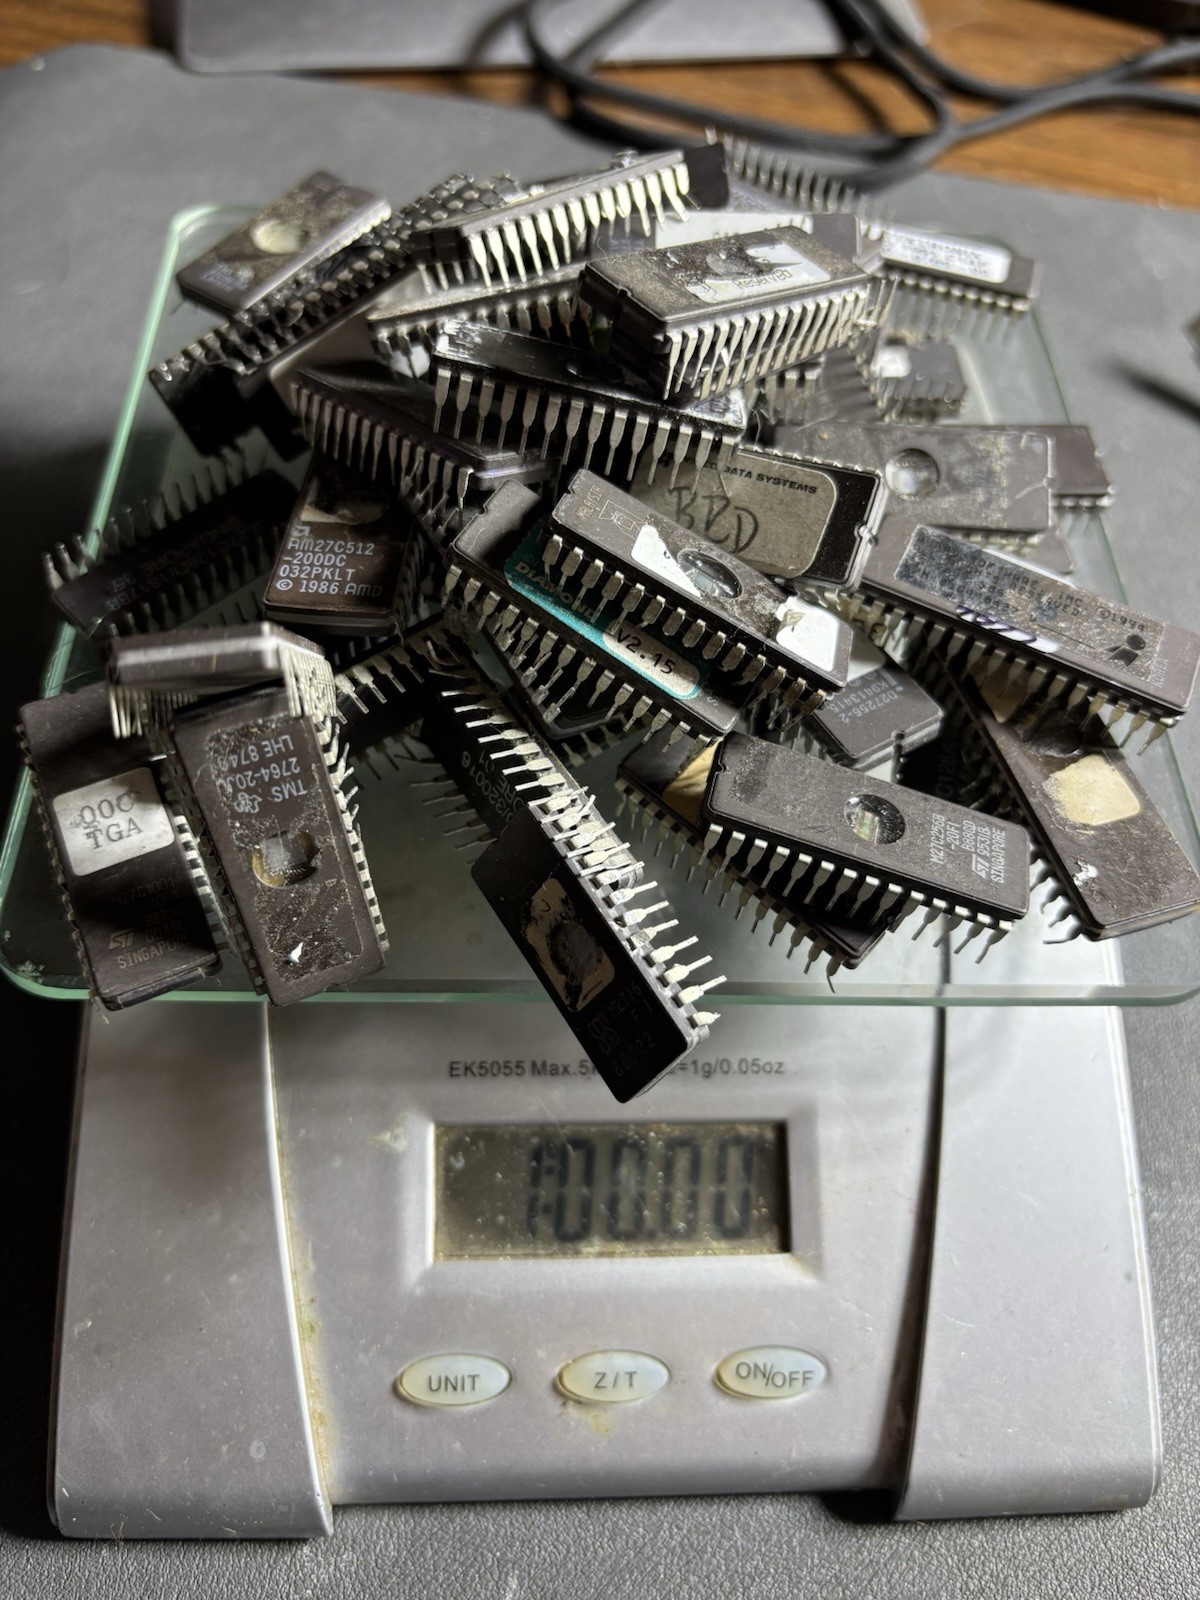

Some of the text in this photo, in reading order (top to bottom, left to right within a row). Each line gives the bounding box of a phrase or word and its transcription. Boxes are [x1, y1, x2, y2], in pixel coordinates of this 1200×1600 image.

[756, 473, 818, 495] SYSTEMS
[576, 485, 605, 520] MALAYSIA
[283, 551, 347, 567] -200DC
[287, 538, 376, 556] AM27C512
[279, 564, 356, 581] 032PKLT
[299, 580, 339, 595] 1986
[344, 583, 382, 597] AMD
[617, 628, 676, 674] V2.15
[839, 690, 899, 723] D27256-2
[262, 734, 294, 758] LHE
[271, 779, 308, 802] TMS
[86, 817, 143, 849] TGA
[930, 813, 945, 865] M27C256B
[990, 827, 1006, 884] SINGAPORE
[449, 1060, 526, 1078] EK5055
[531, 1059, 598, 1077] Max.5
[428, 1373, 480, 1393] UNIT
[735, 1361, 814, 1390] ON/OFF
